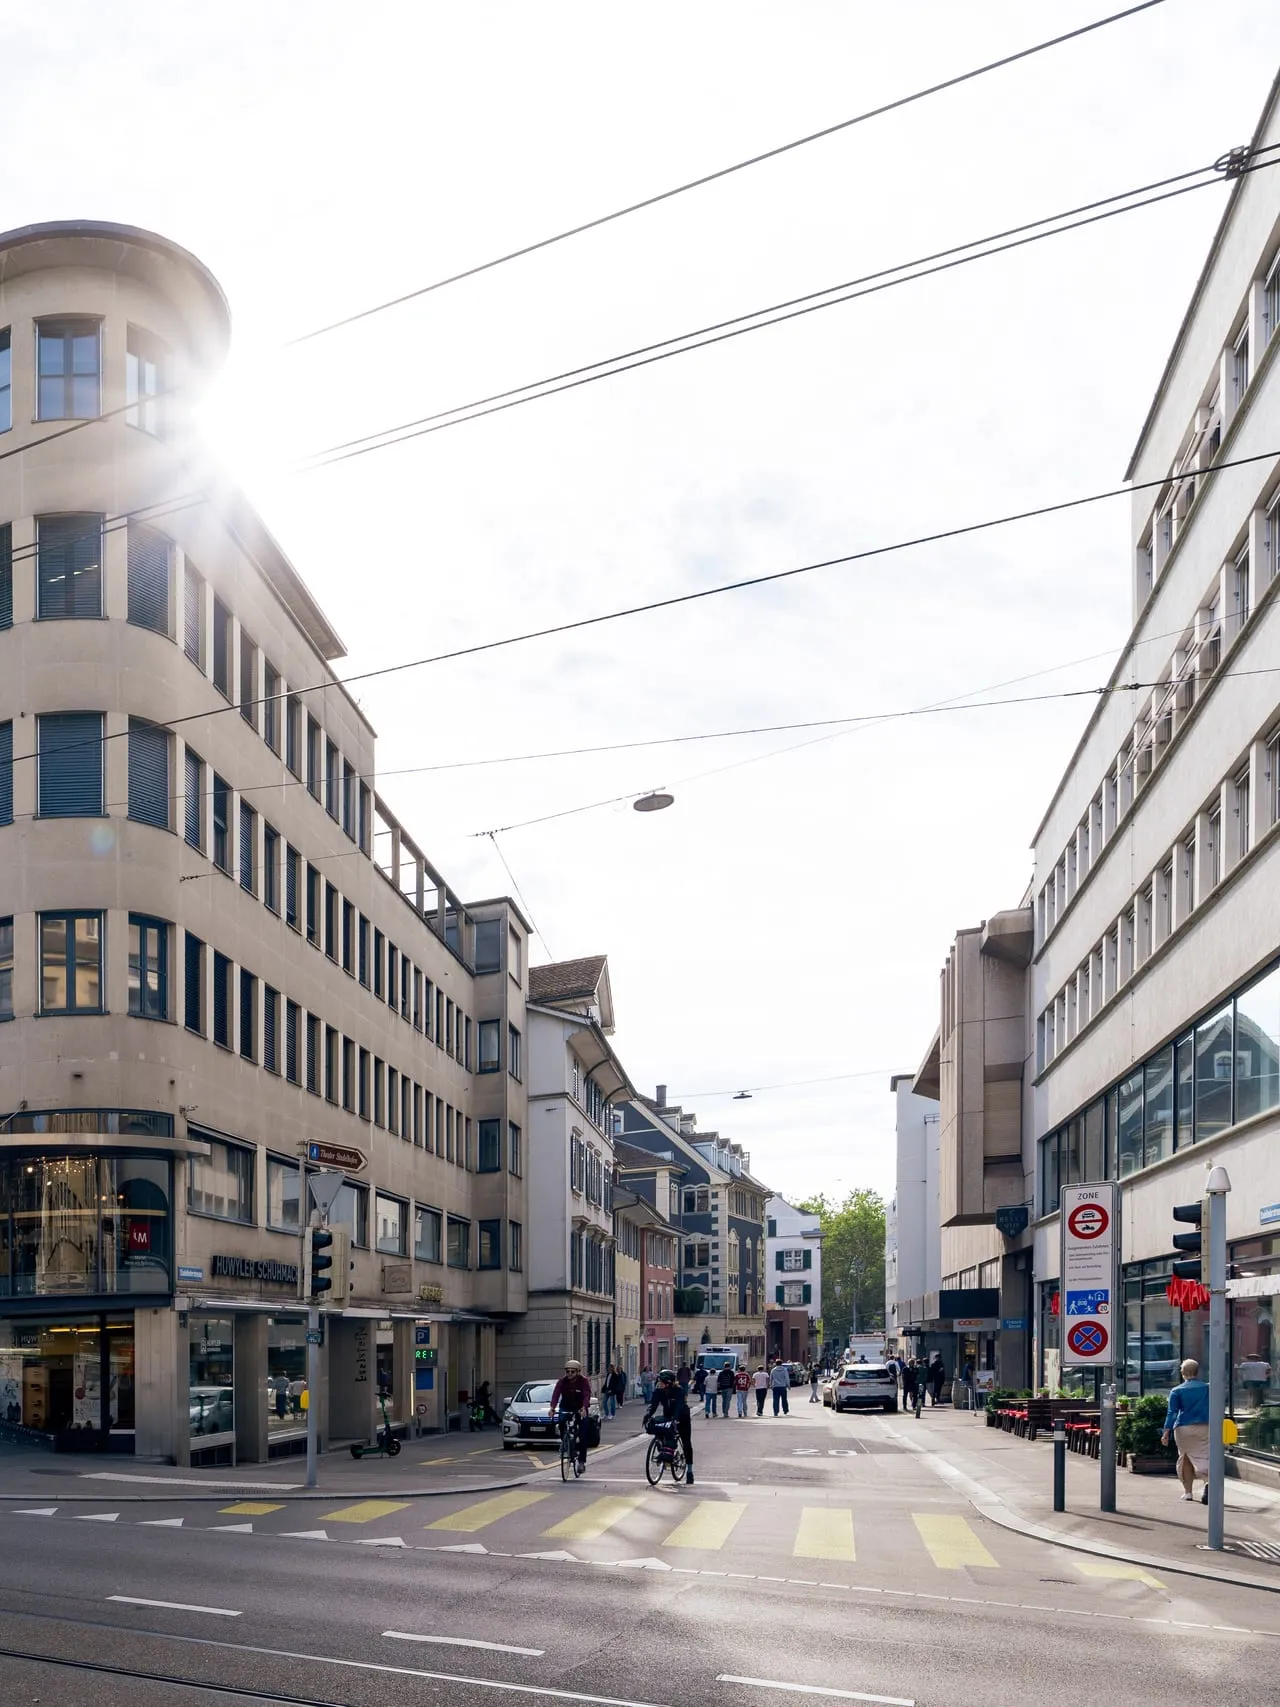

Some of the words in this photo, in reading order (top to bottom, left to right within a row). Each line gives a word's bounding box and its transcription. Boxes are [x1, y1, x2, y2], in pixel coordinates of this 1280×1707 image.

[1077, 1191, 1100, 1201] ZONE
[216, 1256, 255, 1278] HUWYLER
[791, 1448, 858, 1457] 20
